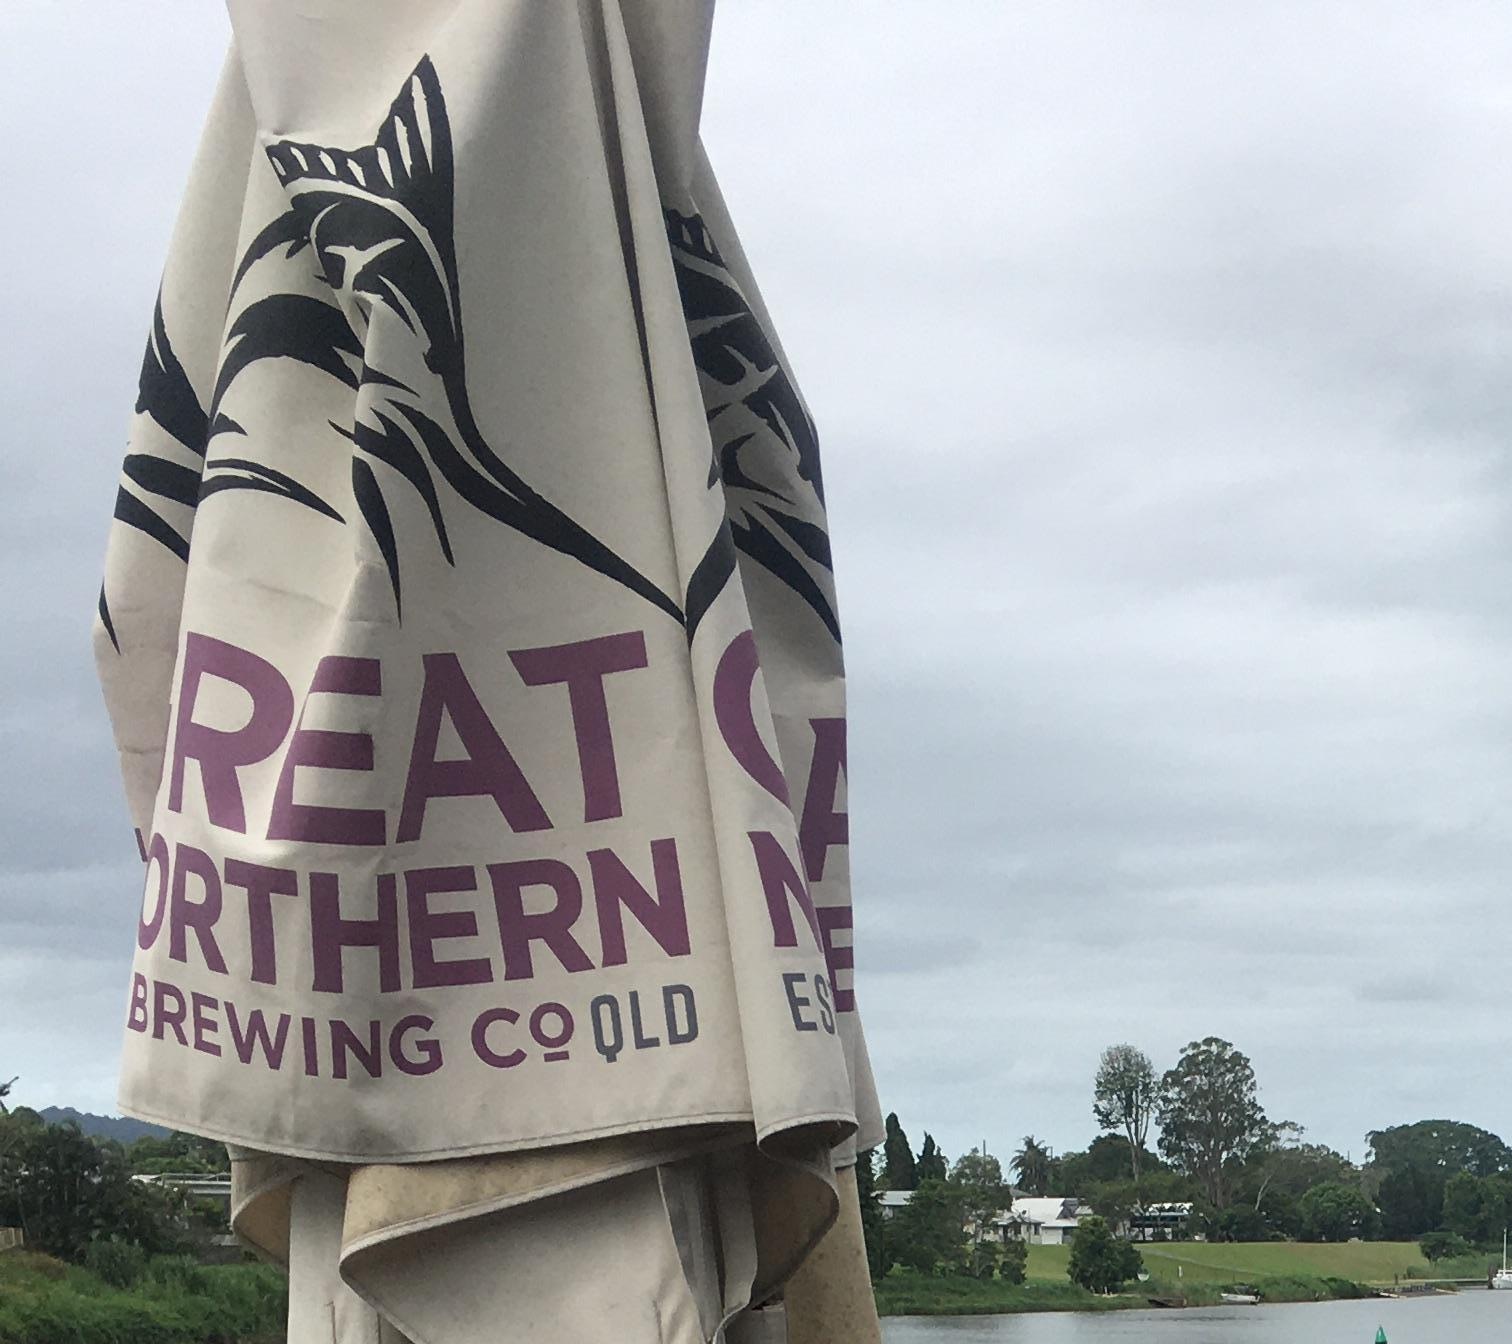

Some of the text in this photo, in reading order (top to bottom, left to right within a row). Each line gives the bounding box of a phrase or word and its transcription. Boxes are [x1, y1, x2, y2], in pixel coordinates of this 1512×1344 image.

[168, 630, 649, 846] REAT
[137, 832, 692, 994] ORTHERN
[128, 973, 444, 1079] BREWING
[590, 984, 699, 1064] QLD
[782, 972, 835, 1035] ES
